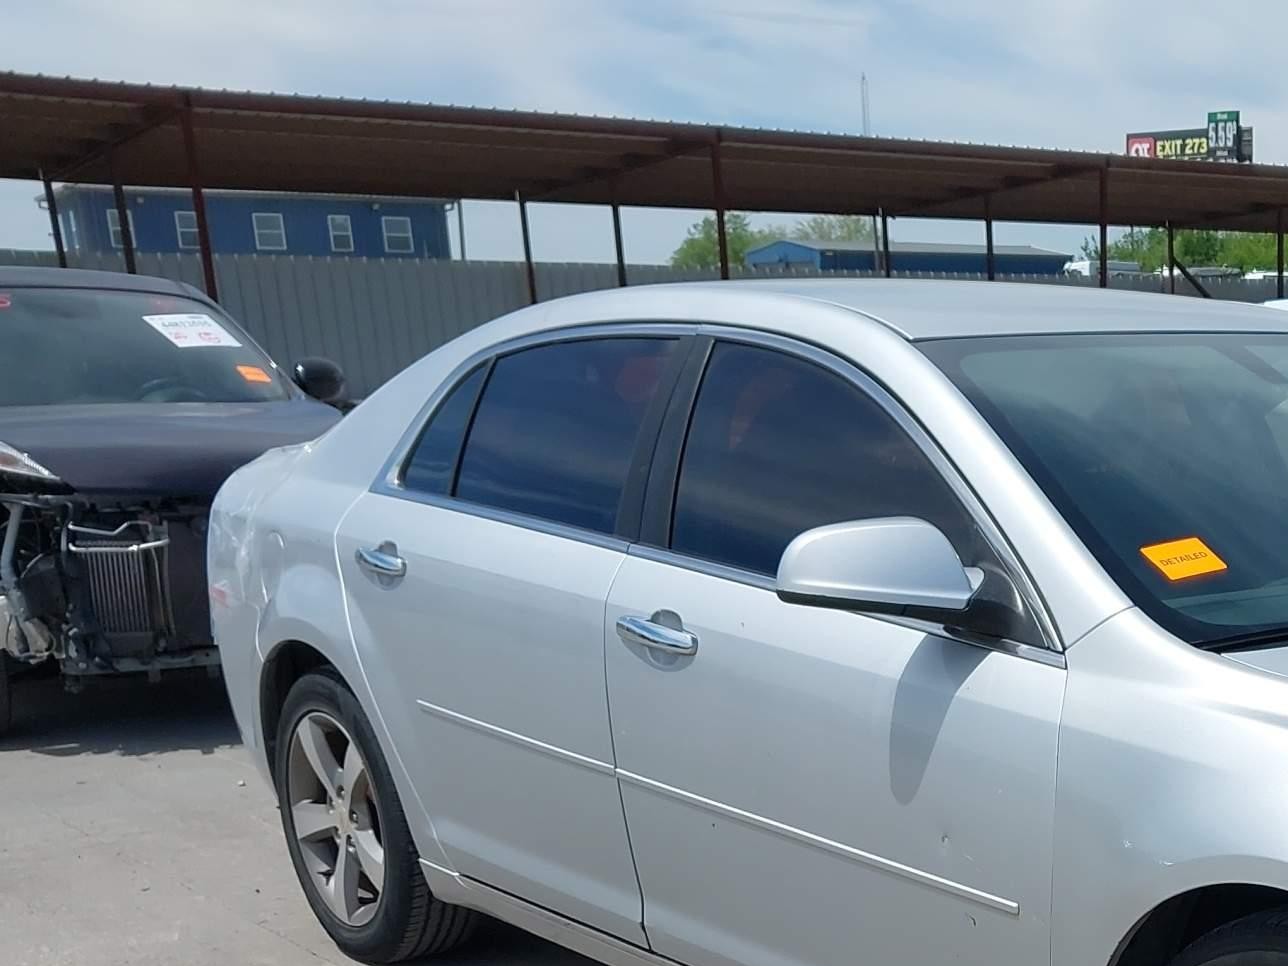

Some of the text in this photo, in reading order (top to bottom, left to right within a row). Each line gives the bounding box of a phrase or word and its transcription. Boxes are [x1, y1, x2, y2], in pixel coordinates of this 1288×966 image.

[1156, 137, 1208, 156] EXIT 273
[1159, 551, 1209, 567] DETAILED
